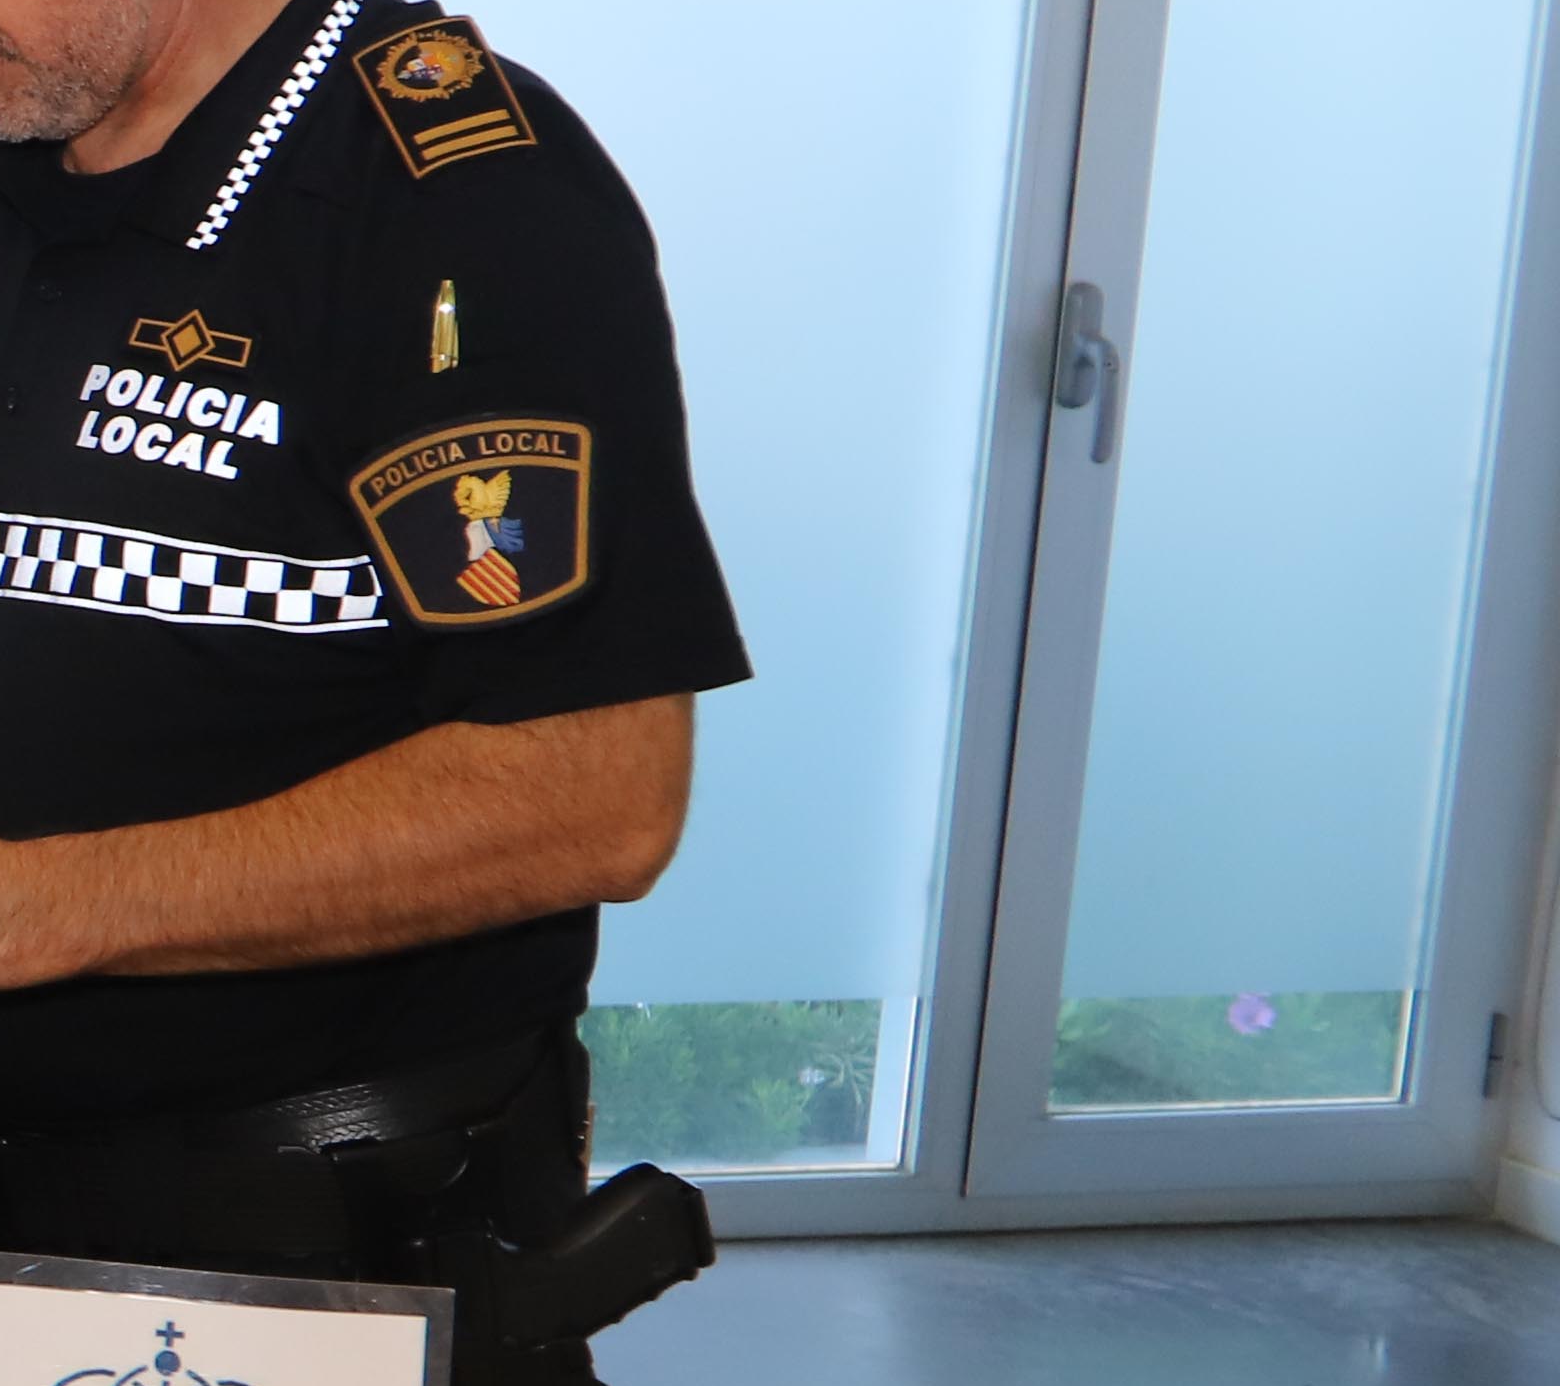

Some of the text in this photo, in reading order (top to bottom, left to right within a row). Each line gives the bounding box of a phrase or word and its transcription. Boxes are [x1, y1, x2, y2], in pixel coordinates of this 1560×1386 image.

[79, 364, 280, 445] POLICIA
[76, 410, 239, 480] LOCAL
[370, 432, 567, 496] POLICIA LOCAL
